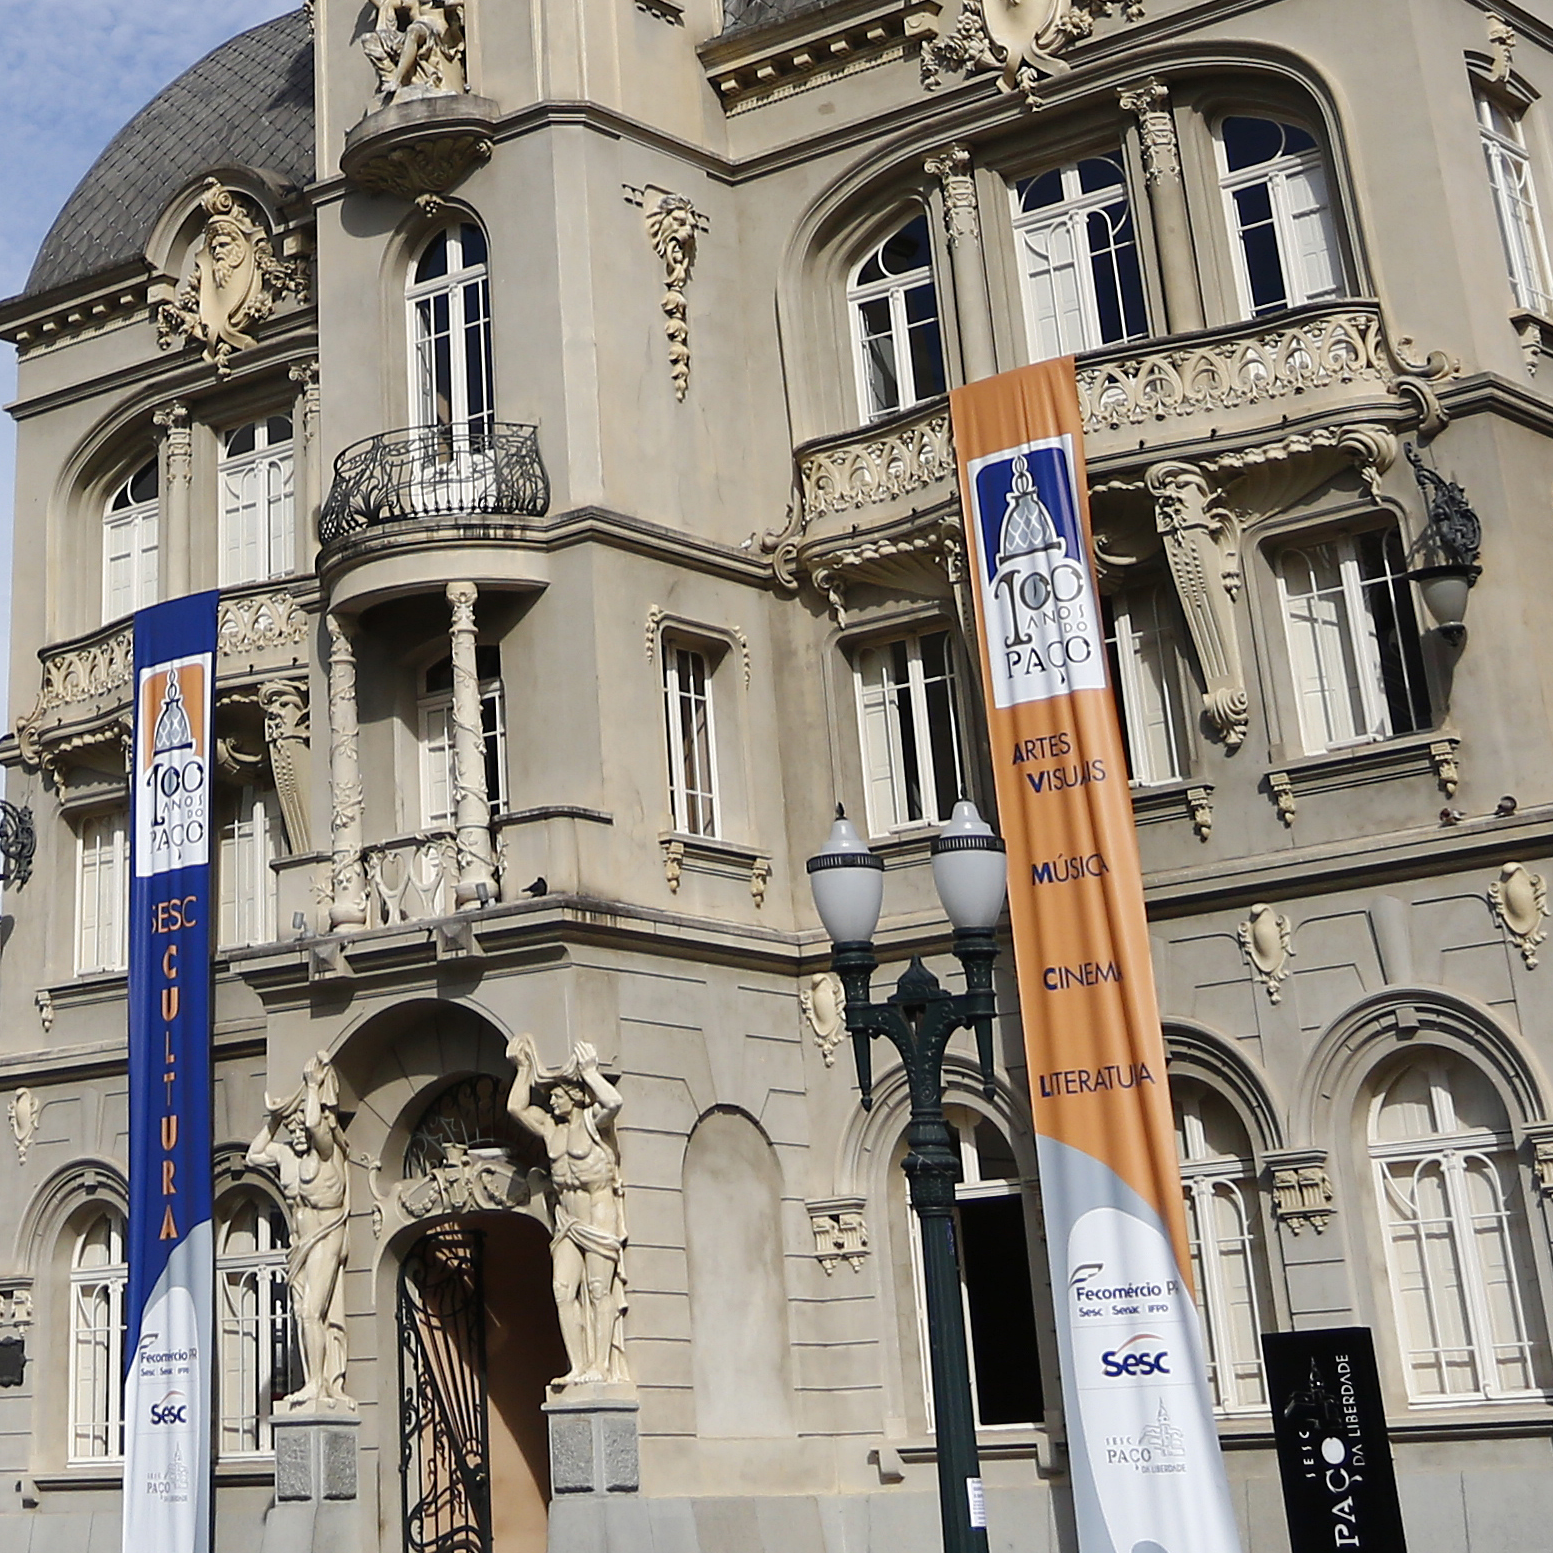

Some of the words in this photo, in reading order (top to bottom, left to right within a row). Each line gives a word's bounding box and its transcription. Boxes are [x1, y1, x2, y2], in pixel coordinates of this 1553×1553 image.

[994, 563, 1084, 649] 100
[1026, 604, 1084, 630] ANOS
[1064, 621, 1087, 633] DO
[1005, 635, 1091, 685] PAÇO
[1011, 732, 1072, 766] ARTES
[146, 760, 204, 828] 100
[162, 794, 203, 814] ANOS
[187, 808, 204, 820] DO
[149, 820, 204, 861] PAÇO
[1042, 960, 1124, 991] CINEM
[158, 944, 180, 1241] CULTURA
[1076, 1282, 1162, 1302] Fecomércio
[1078, 1307, 1103, 1317] Sesc
[1102, 1351, 1170, 1377] Sesc
[1335, 1354, 1361, 1437] LIBERDADE
[150, 1404, 187, 1425] Sesc
[1107, 1447, 1152, 1471] PAÇO
[1298, 1430, 1316, 1478] SESC
[1352, 1444, 1365, 1466] DA
[1321, 1437, 1364, 1547] PAÇO
